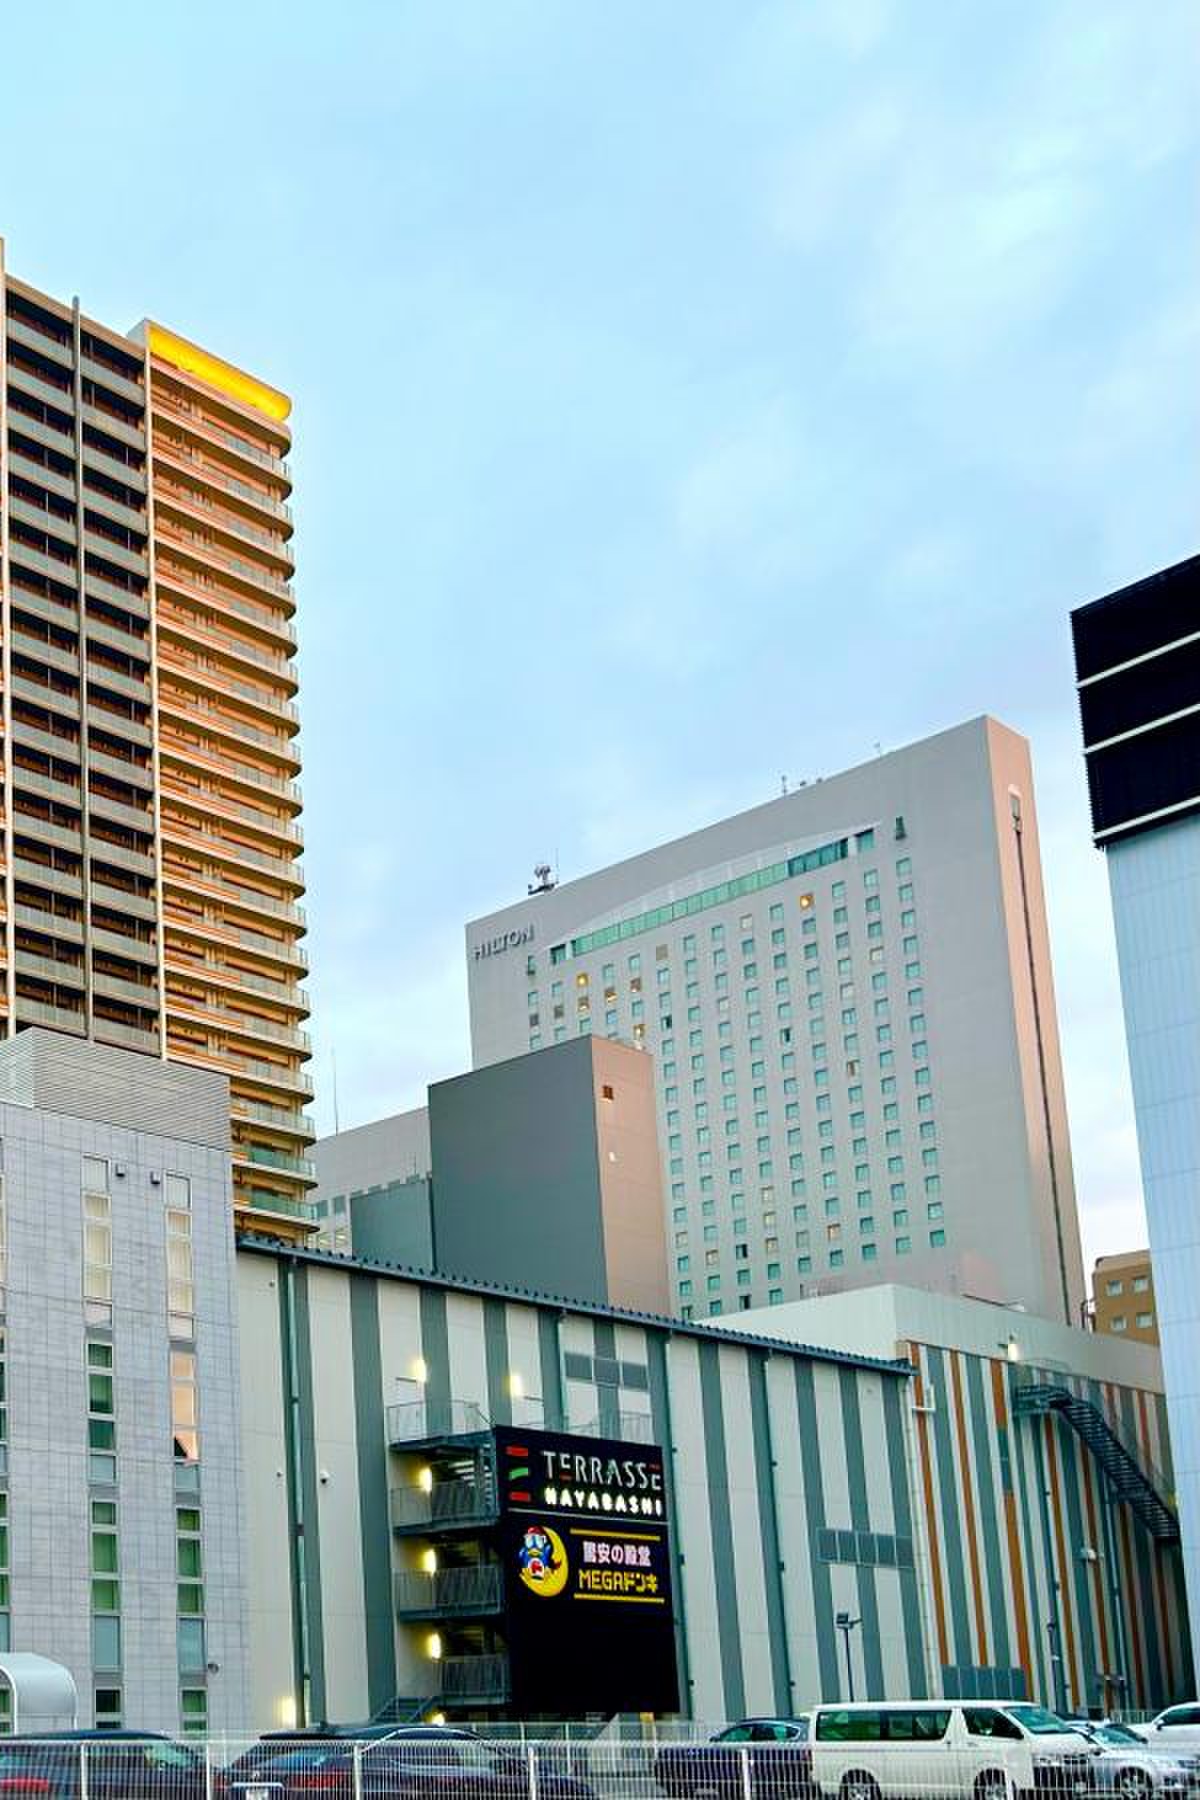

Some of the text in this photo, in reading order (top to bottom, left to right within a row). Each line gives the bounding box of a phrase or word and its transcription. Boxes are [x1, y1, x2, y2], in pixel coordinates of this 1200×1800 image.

[542, 1450, 661, 1491] TERRASSE
[578, 1569, 658, 1593] MEGAドンキ
